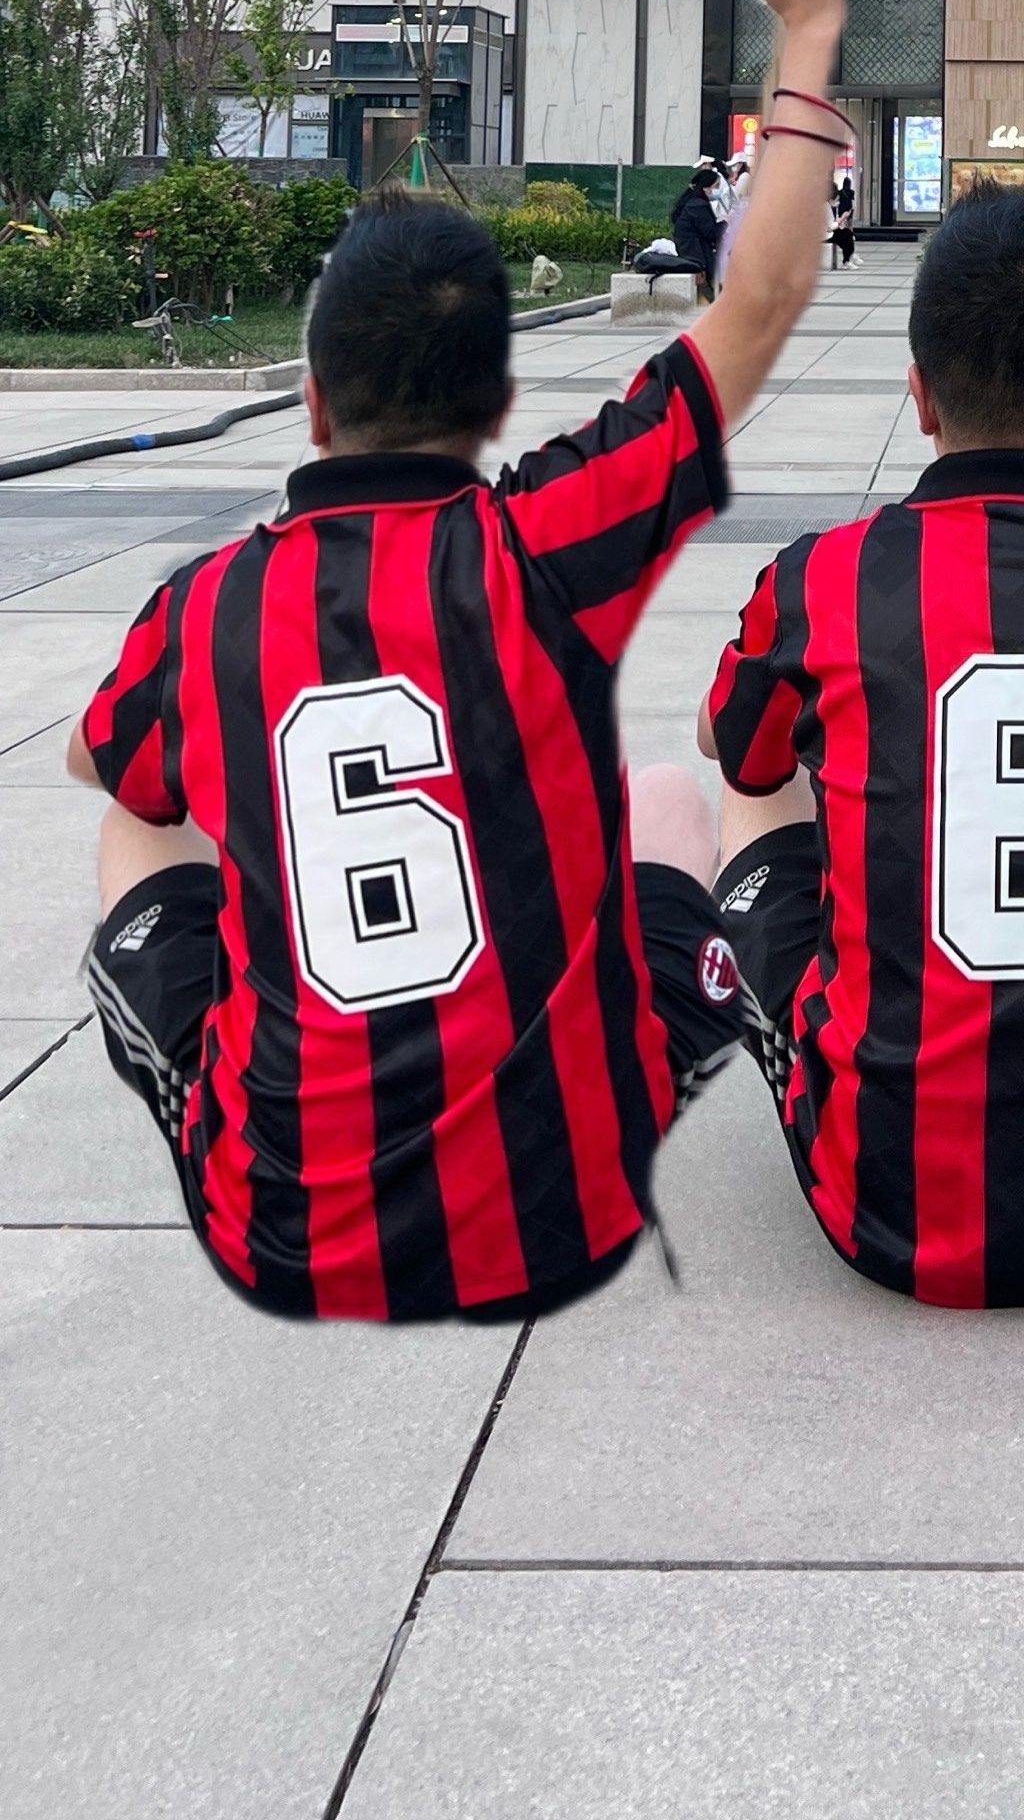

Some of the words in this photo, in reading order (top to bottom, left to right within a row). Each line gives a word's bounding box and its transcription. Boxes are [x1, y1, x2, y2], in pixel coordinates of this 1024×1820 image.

[272, 673, 487, 1015] 6
[719, 864, 771, 915] adidas
[109, 903, 163, 954] adidas
